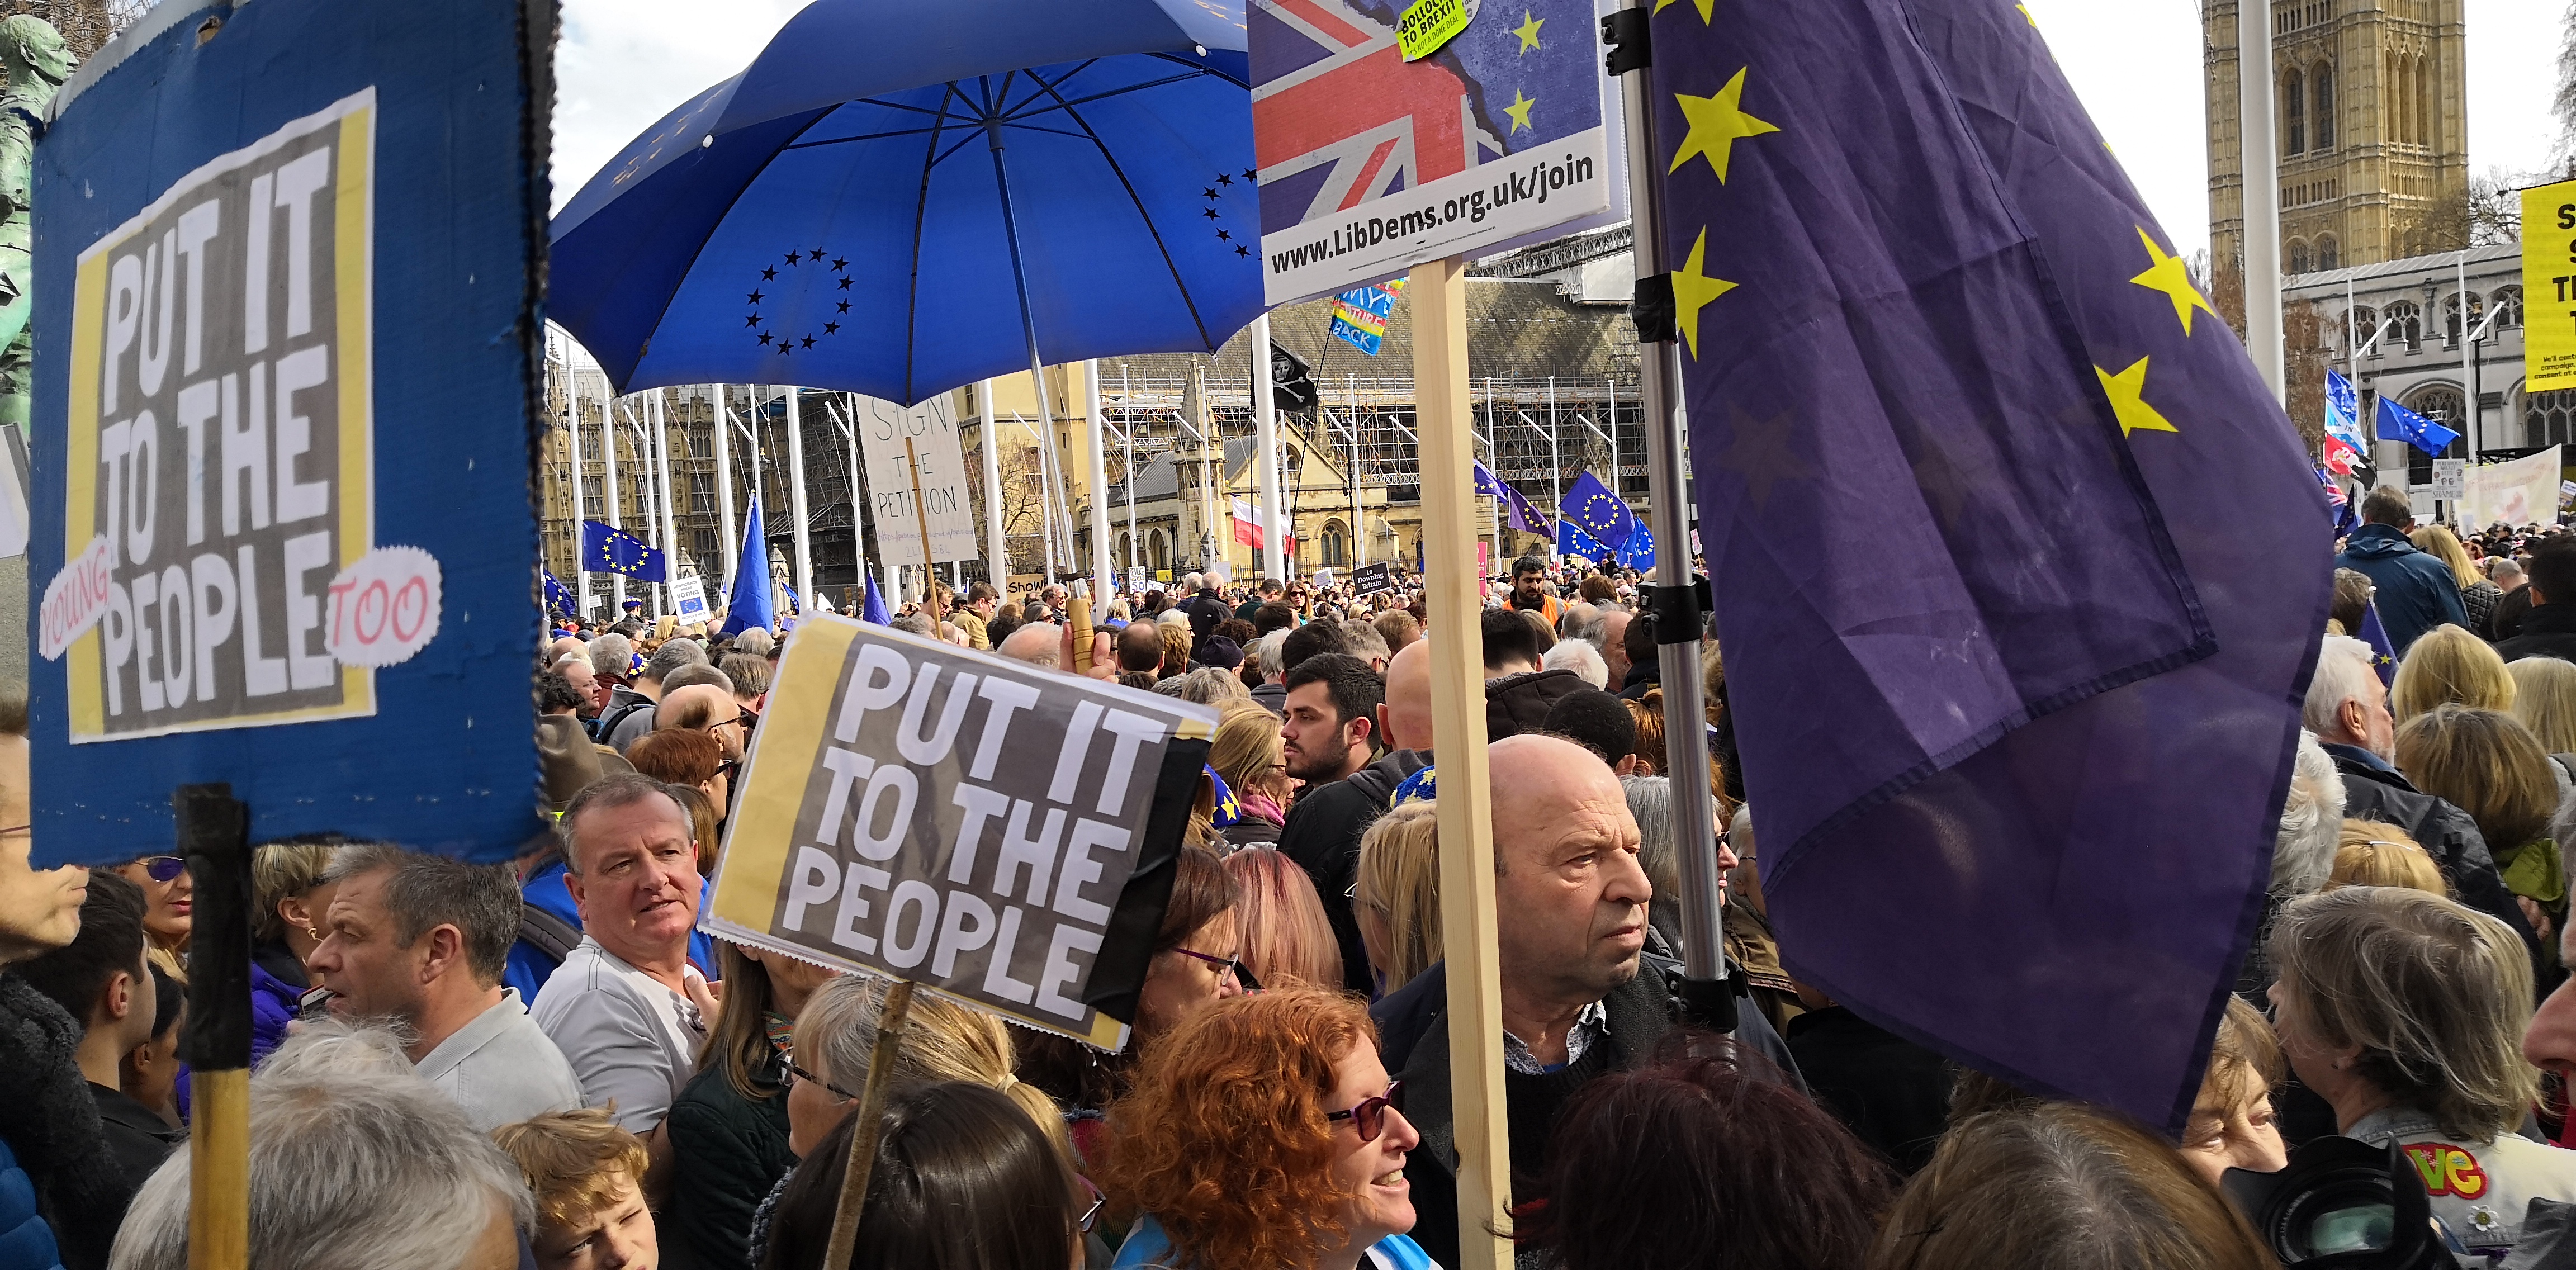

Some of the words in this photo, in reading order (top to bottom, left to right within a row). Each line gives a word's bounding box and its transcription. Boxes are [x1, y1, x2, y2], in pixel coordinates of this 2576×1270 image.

[1403, 30, 1417, 48] TO
[1420, 0, 1456, 35] BREXIT
[1418, 36, 1427, 52] NOT
[1432, 23, 1446, 40] DONE
[1446, 14, 1459, 29] DEAL
[1271, 154, 1594, 274] www.LibDems.org.uk/join
[104, 197, 220, 417] PUT
[244, 146, 330, 354] IT
[1342, 287, 1385, 309] MY
[1332, 321, 1370, 348] BACK
[1338, 302, 1383, 333] UTURE
[872, 394, 948, 442] SIGN
[101, 409, 158, 566] TO
[177, 344, 329, 547] THE
[892, 453, 933, 478] THE
[41, 545, 108, 656] YOUNG
[676, 590, 699, 599] VOTING
[1131, 582, 1144, 590] 50
[1357, 572, 1384, 584] Downing
[1362, 580, 1382, 590] Britain
[103, 530, 336, 716] PEOPLE
[329, 575, 429, 646] TOO
[834, 643, 1041, 781] PUT
[1047, 699, 1167, 817] IT
[815, 746, 920, 861] TO
[947, 781, 1132, 926] THE
[782, 845, 1105, 1021] PEOPLE
